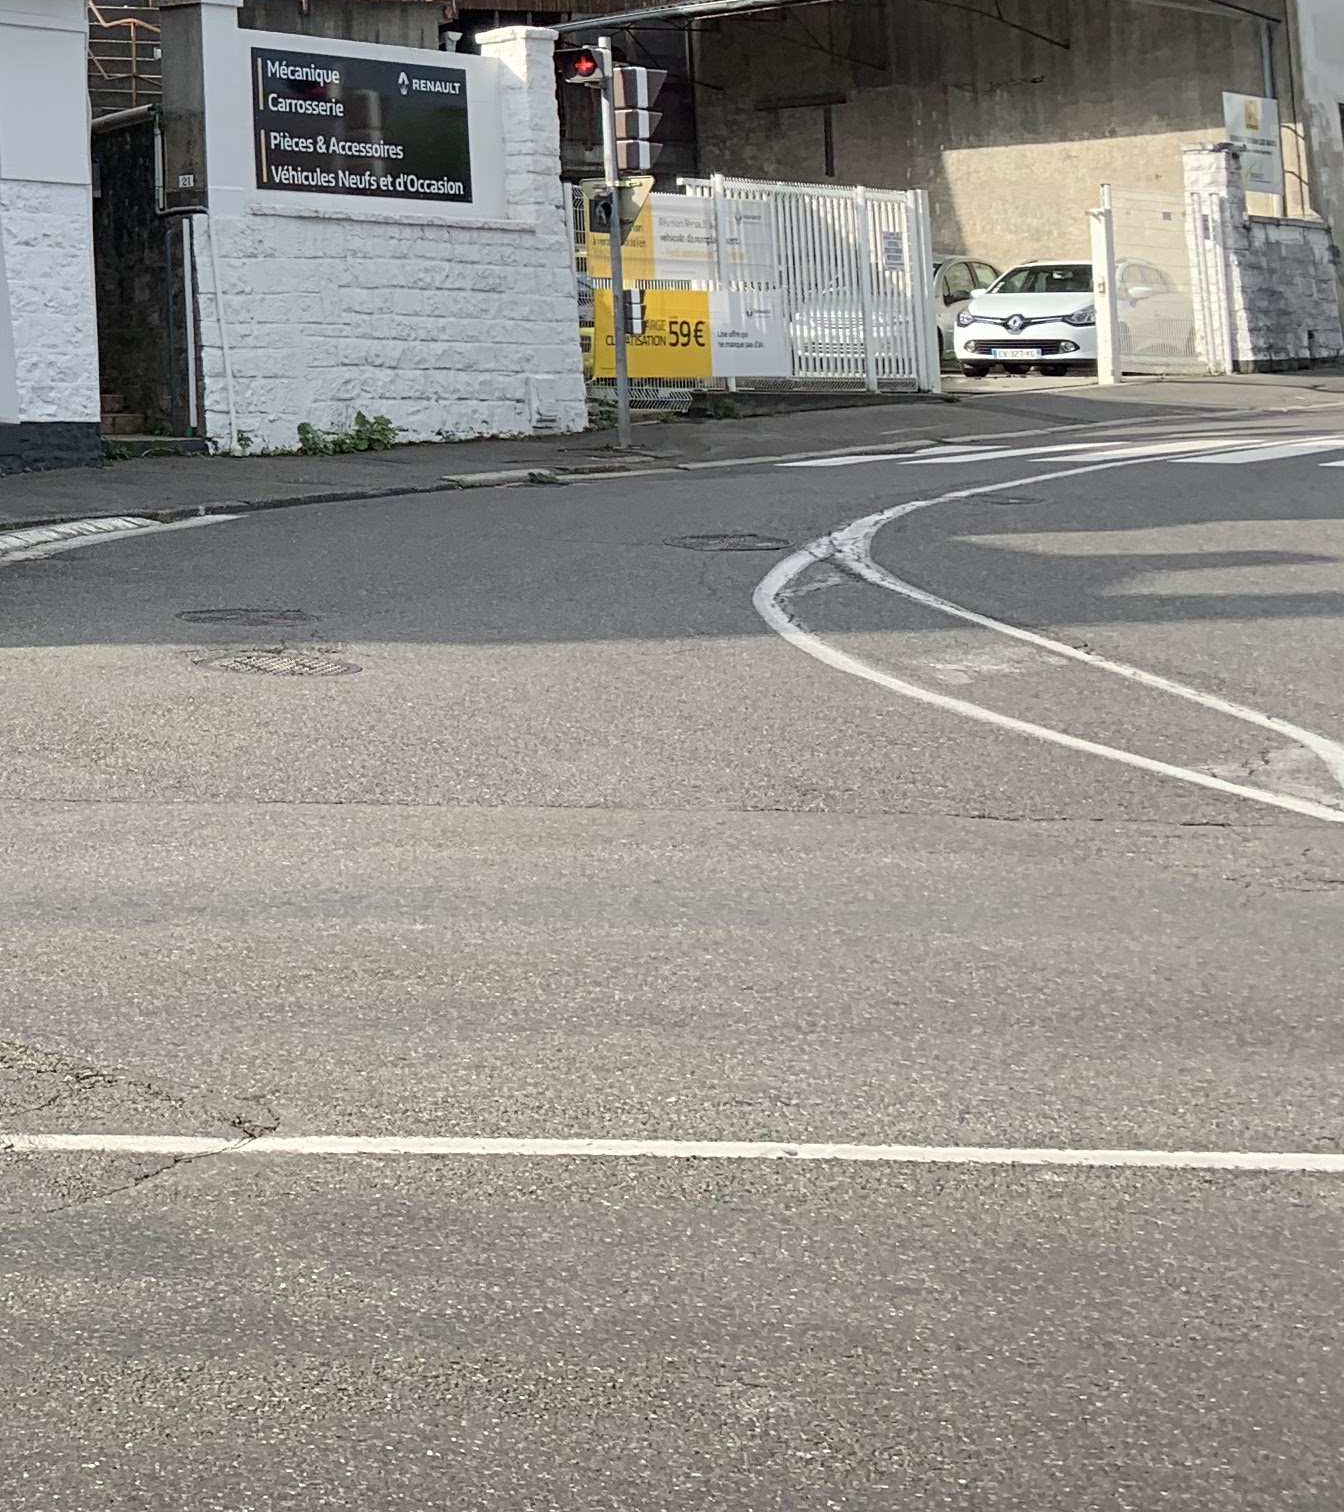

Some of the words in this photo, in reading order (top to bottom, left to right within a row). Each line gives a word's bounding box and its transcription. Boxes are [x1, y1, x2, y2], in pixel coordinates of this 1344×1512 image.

[266, 59, 340, 86] Mécanique
[412, 78, 462, 95] RENAULT
[268, 93, 344, 117] Carrosserie
[270, 131, 313, 153] Pièces
[316, 136, 327, 153] &
[329, 136, 404, 160] Accessoires
[182, 176, 191, 186] 21
[271, 164, 336, 187] Véhicules
[338, 169, 378, 190] Neufs
[379, 175, 394, 191] et
[396, 176, 464, 196] d'Occasion
